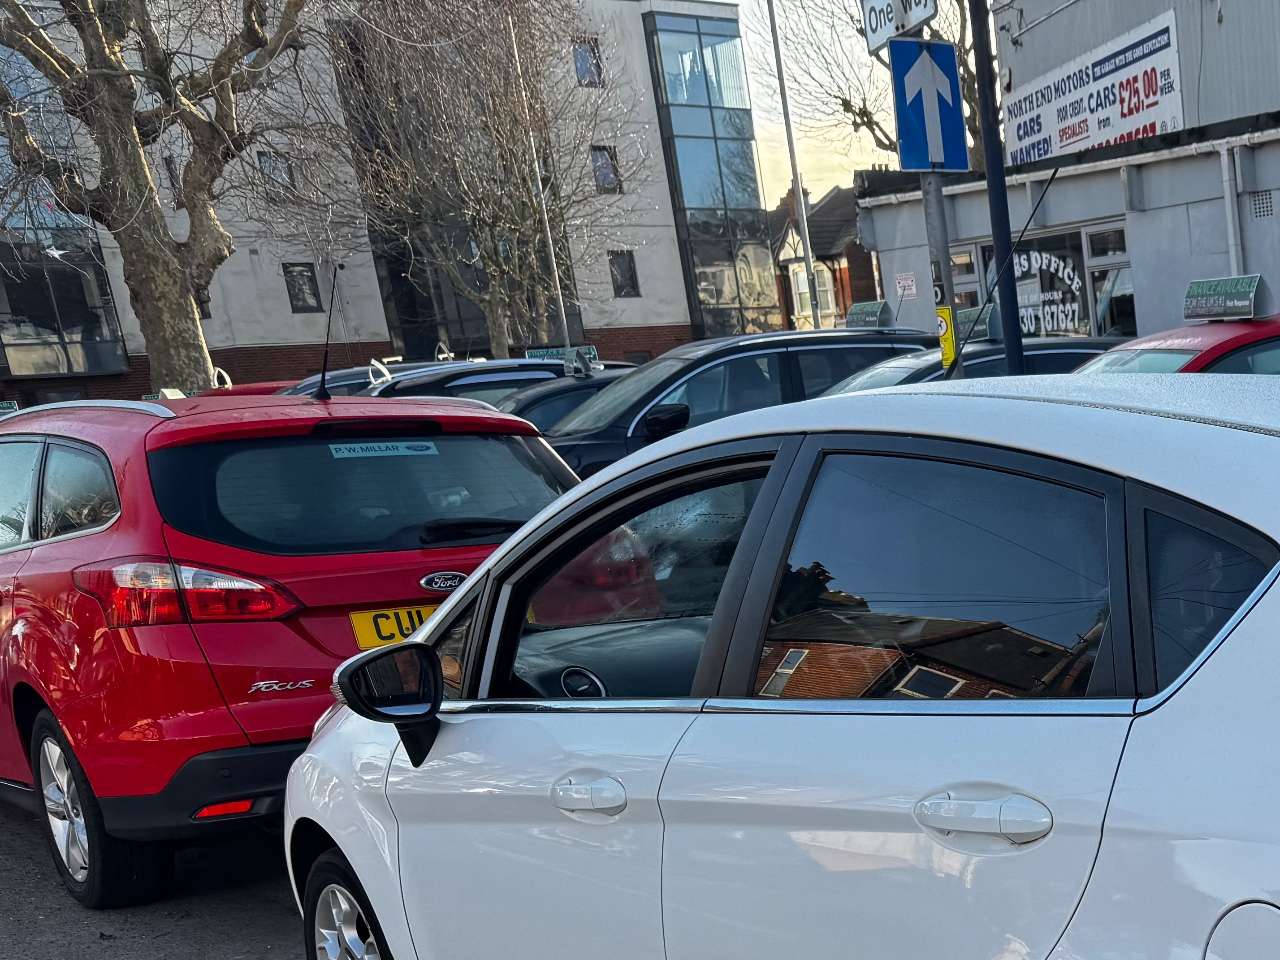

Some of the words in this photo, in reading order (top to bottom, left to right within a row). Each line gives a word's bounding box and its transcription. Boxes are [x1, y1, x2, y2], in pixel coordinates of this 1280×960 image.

[869, 3, 894, 34] One
[1160, 68, 1171, 84] PER
[1160, 80, 1175, 97] WEEK
[1007, 93, 1035, 122] NORTH
[1035, 85, 1053, 108] END
[1053, 65, 1091, 100] MOTORS
[1087, 83, 1117, 114] CARS
[1016, 113, 1042, 142] CARS
[1057, 104, 1069, 124] POOR
[1058, 118, 1089, 142] SPECIALISTS
[1011, 133, 1053, 165] WANTED!
[1029, 250, 1082, 296] OFFICE
[1038, 303, 1079, 335] 187627
[432, 575, 459, 588] Ford
